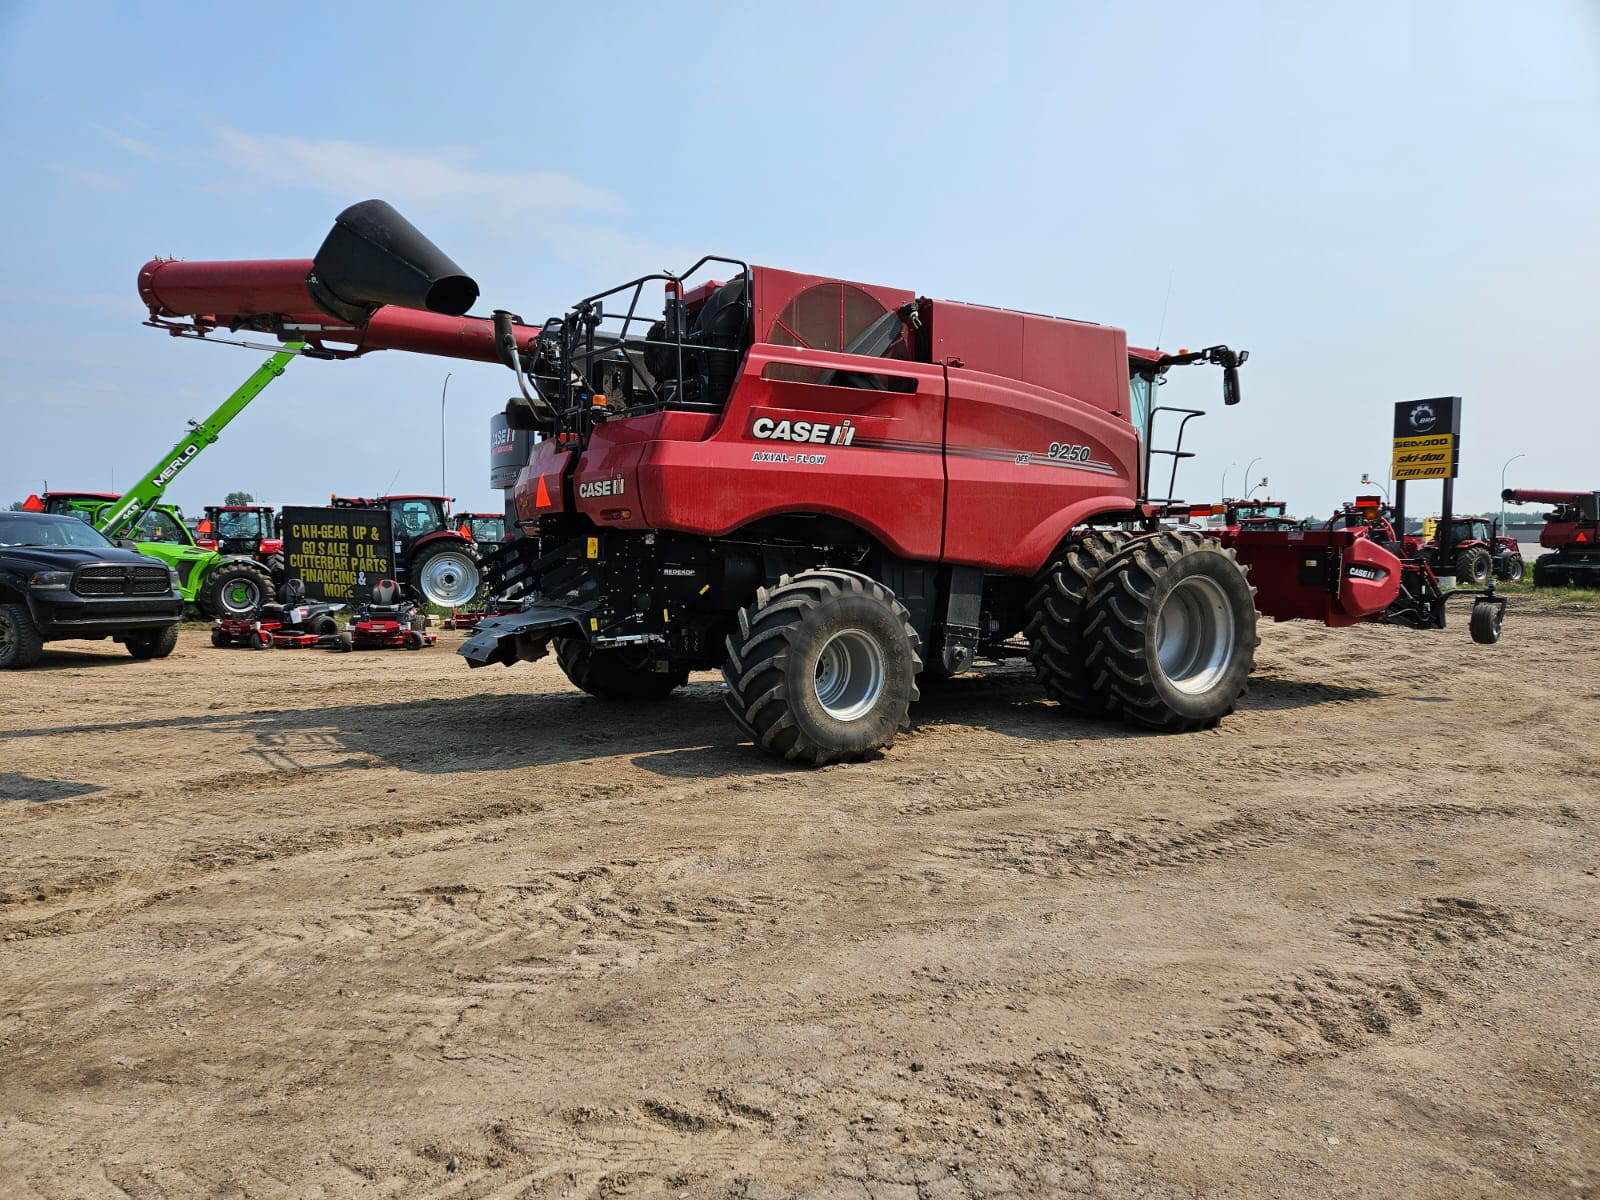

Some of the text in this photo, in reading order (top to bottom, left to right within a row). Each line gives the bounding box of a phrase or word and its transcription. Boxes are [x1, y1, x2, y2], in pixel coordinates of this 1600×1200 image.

[752, 417, 830, 444] CASE
[1048, 441, 1091, 463] 9250
[1397, 452, 1445, 463] ski-doo
[152, 444, 198, 487] MERLO
[1396, 467, 1446, 477] can-am
[579, 480, 611, 498] CASE
[352, 525, 367, 540] UP
[371, 526, 380, 541] &
[302, 541, 376, 558] GO SALE! OIL
[290, 554, 387, 573] CUTTERBAR PARTS
[663, 568, 696, 576] REDEKOP
[300, 568, 367, 586] FINANCING &
[1349, 567, 1368, 578] CASE
